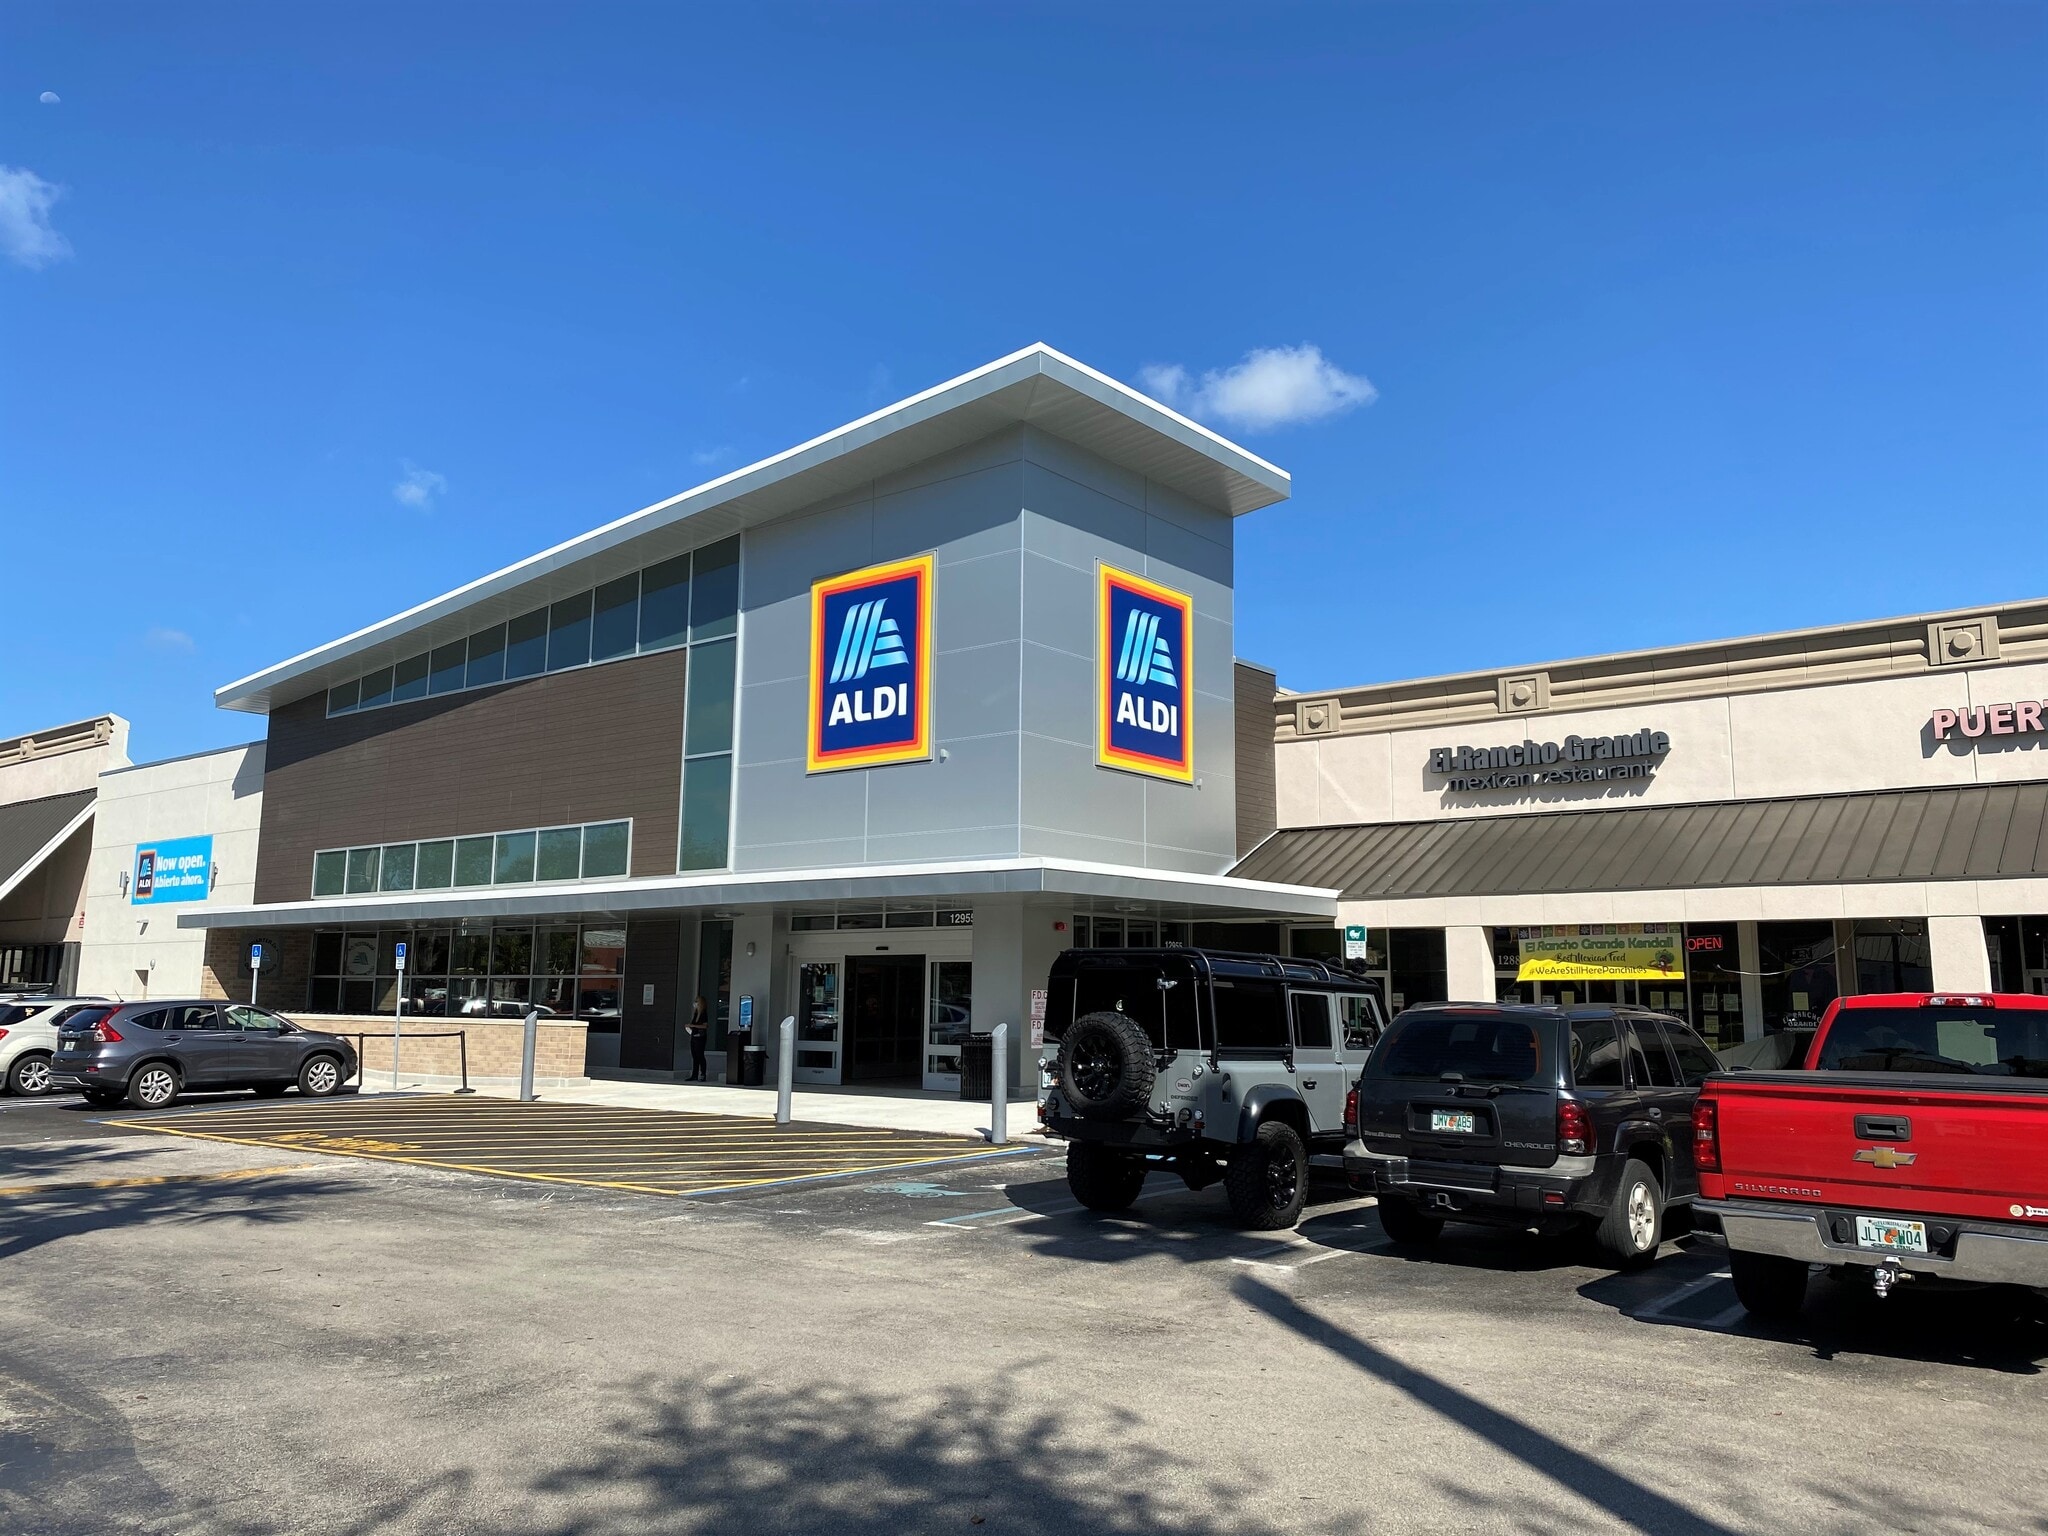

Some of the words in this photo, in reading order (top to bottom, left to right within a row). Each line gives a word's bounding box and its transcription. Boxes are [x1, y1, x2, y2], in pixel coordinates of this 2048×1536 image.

[828, 682, 908, 727] ALDI
[1116, 692, 1178, 737] ALDI
[1932, 699, 2048, 740] PUER
[1430, 747, 1453, 773] El
[1457, 738, 1559, 771] Rancho
[1564, 728, 1670, 763] Grande
[1448, 771, 1533, 793] mexican
[1542, 760, 1655, 786] restaurant
[156, 856, 177, 872] Now
[178, 854, 206, 873] open.
[139, 878, 152, 889] ALDI
[154, 874, 180, 888] Abierto
[180, 872, 205, 886] ahora.
[1525, 941, 1535, 953] El
[1537, 940, 1579, 951] Rancho
[1581, 938, 1626, 950] Grande
[1628, 936, 1674, 948] Kendall
[1686, 937, 1722, 951] OPEN
[1556, 952, 1575, 964] Best
[1504, 1141, 1557, 1150] CHEVROLET
[1735, 1183, 1821, 1197] SILVERADO
[1860, 1226, 1882, 1243] JLT
